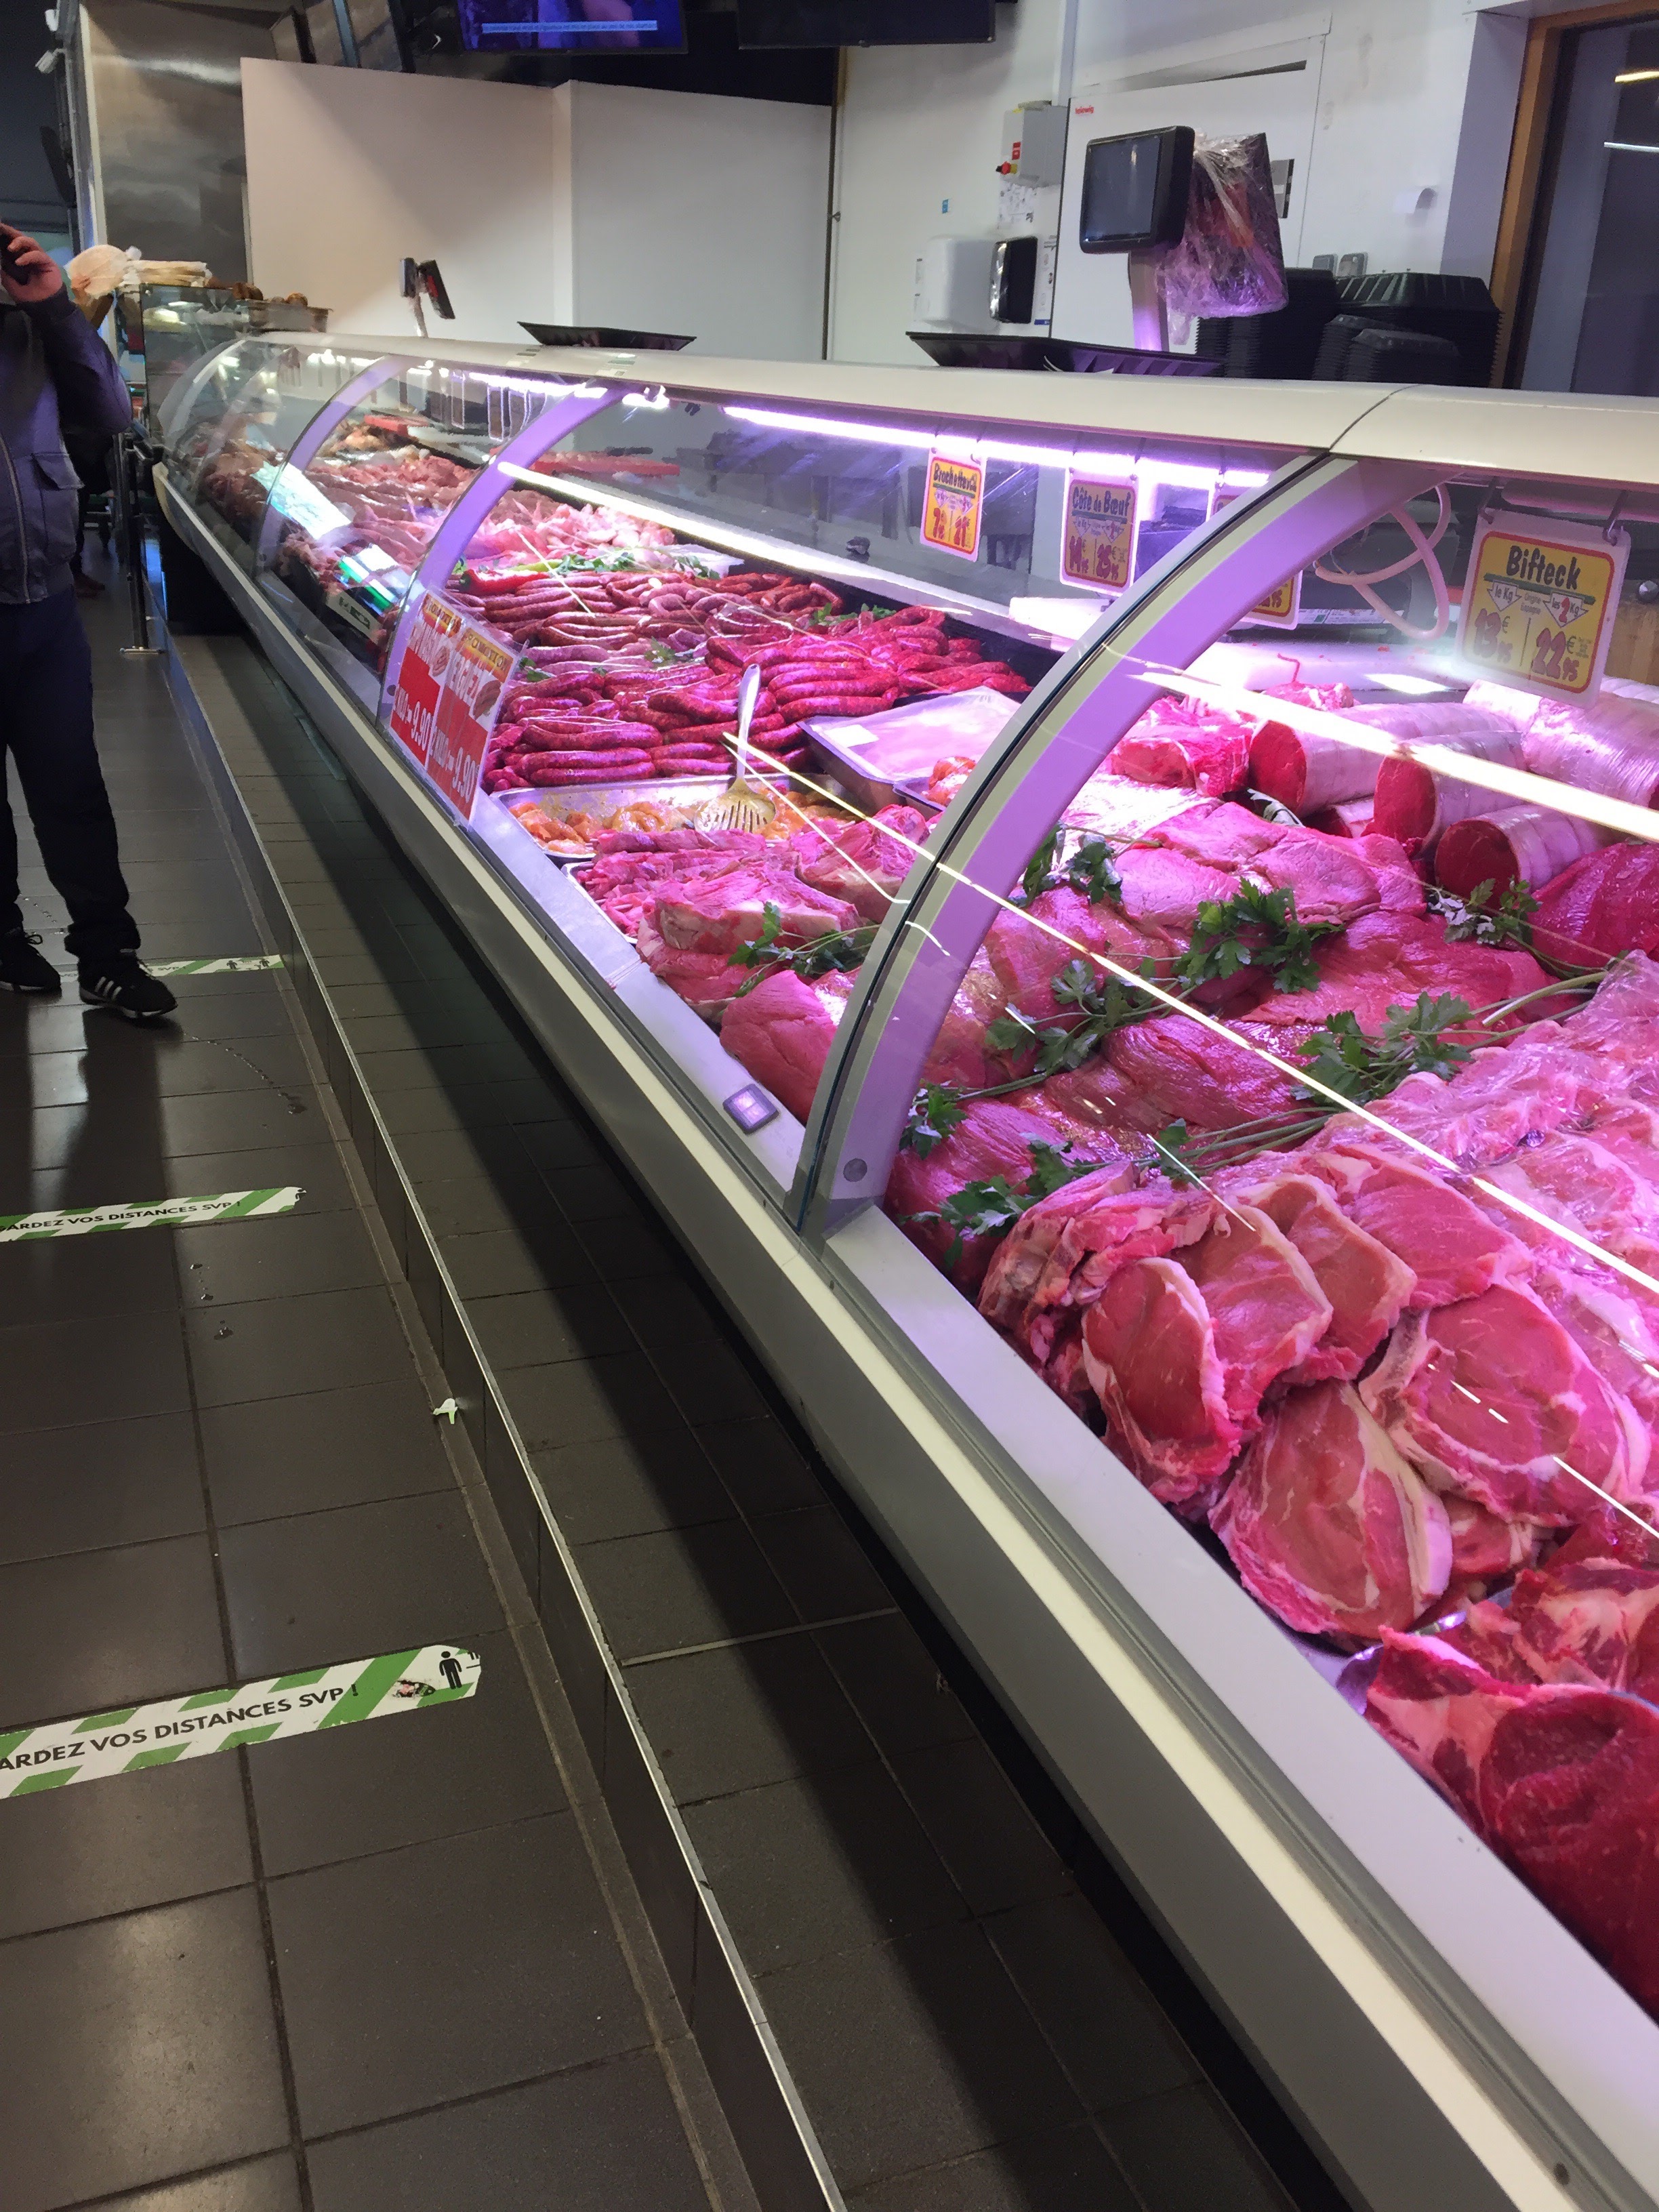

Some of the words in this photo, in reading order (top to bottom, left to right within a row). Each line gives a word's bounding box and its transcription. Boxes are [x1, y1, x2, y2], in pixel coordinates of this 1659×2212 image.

[1073, 487, 1092, 510] Côte
[1093, 494, 1102, 512] de
[1506, 545, 1580, 590] Bifteck
[1502, 587, 1513, 604] Kg
[1532, 628, 1566, 679] 22
[68, 1215, 104, 1225] VOS
[108, 1204, 197, 1221] DISTANCES
[202, 1202, 232, 1211] SVP
[89, 1728, 147, 1753] VOS
[155, 1698, 292, 1740] DISTANCES
[298, 1687, 345, 1709] SVP
